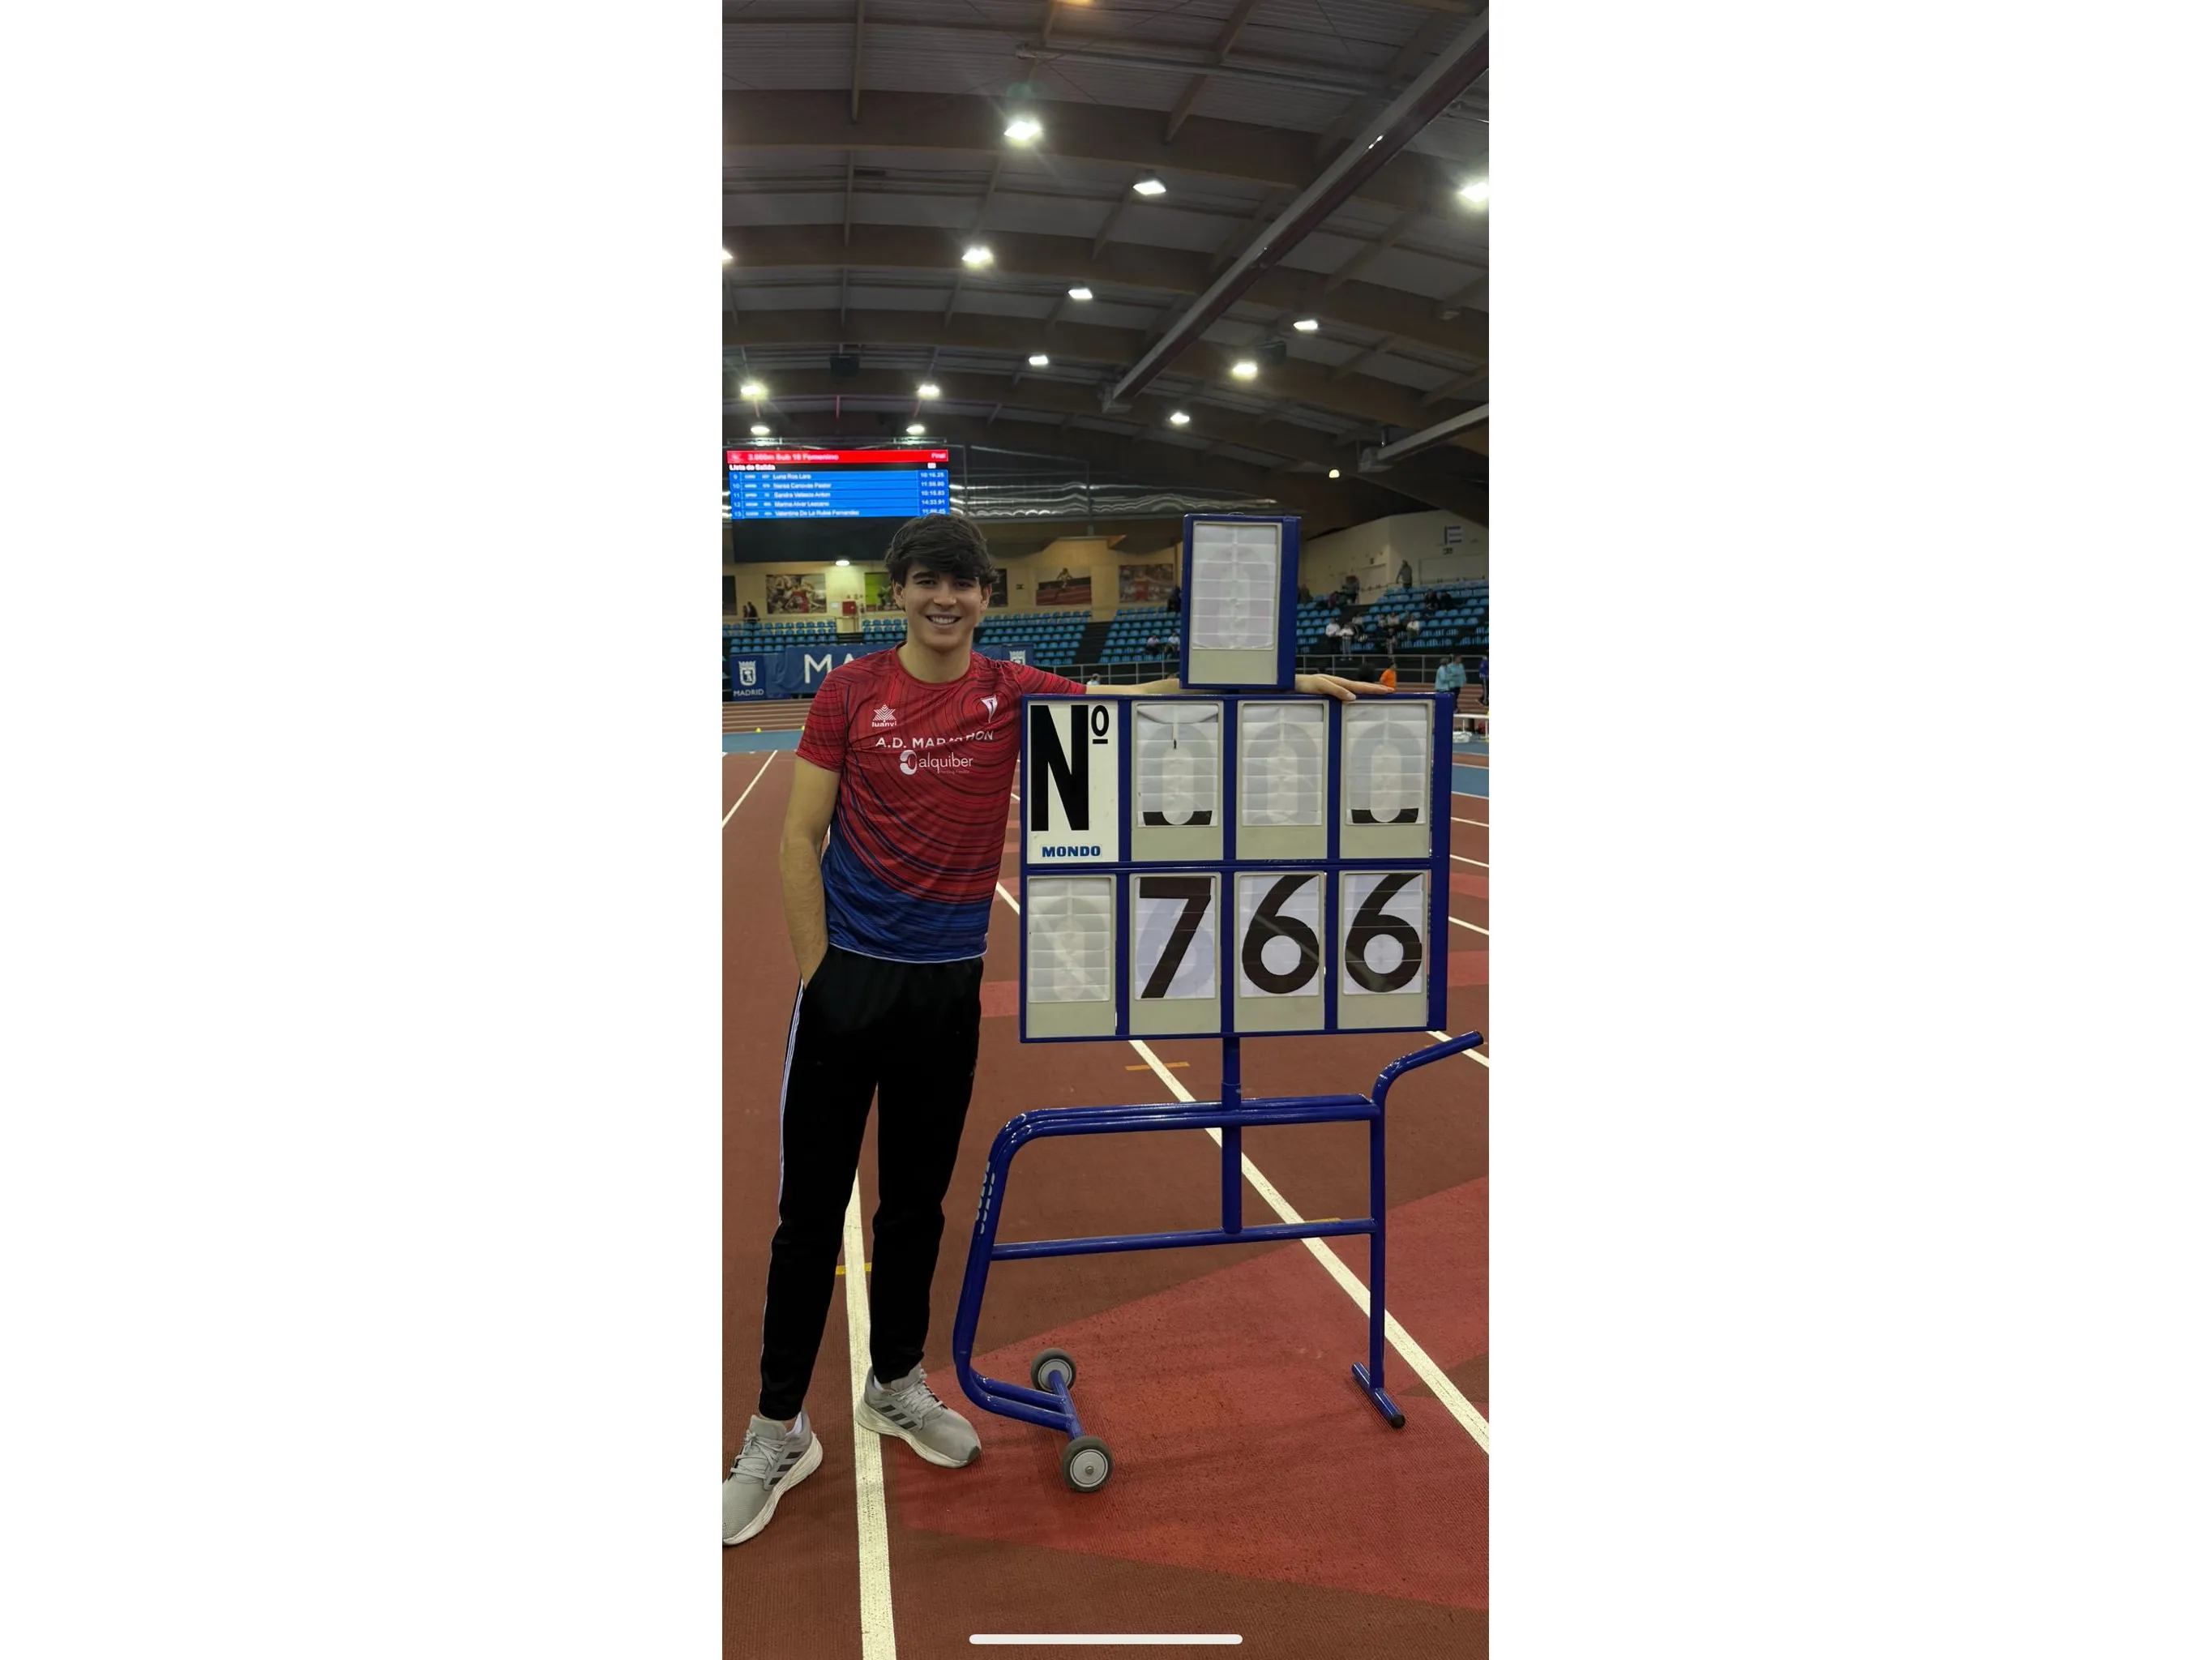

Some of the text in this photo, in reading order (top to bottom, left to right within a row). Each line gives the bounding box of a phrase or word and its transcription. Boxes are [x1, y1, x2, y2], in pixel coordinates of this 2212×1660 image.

[733, 689, 764, 697] MADRID
[875, 737, 907, 748] A.D.
[918, 752, 973, 774] alquiber
[1042, 845, 1101, 858] MONDO
